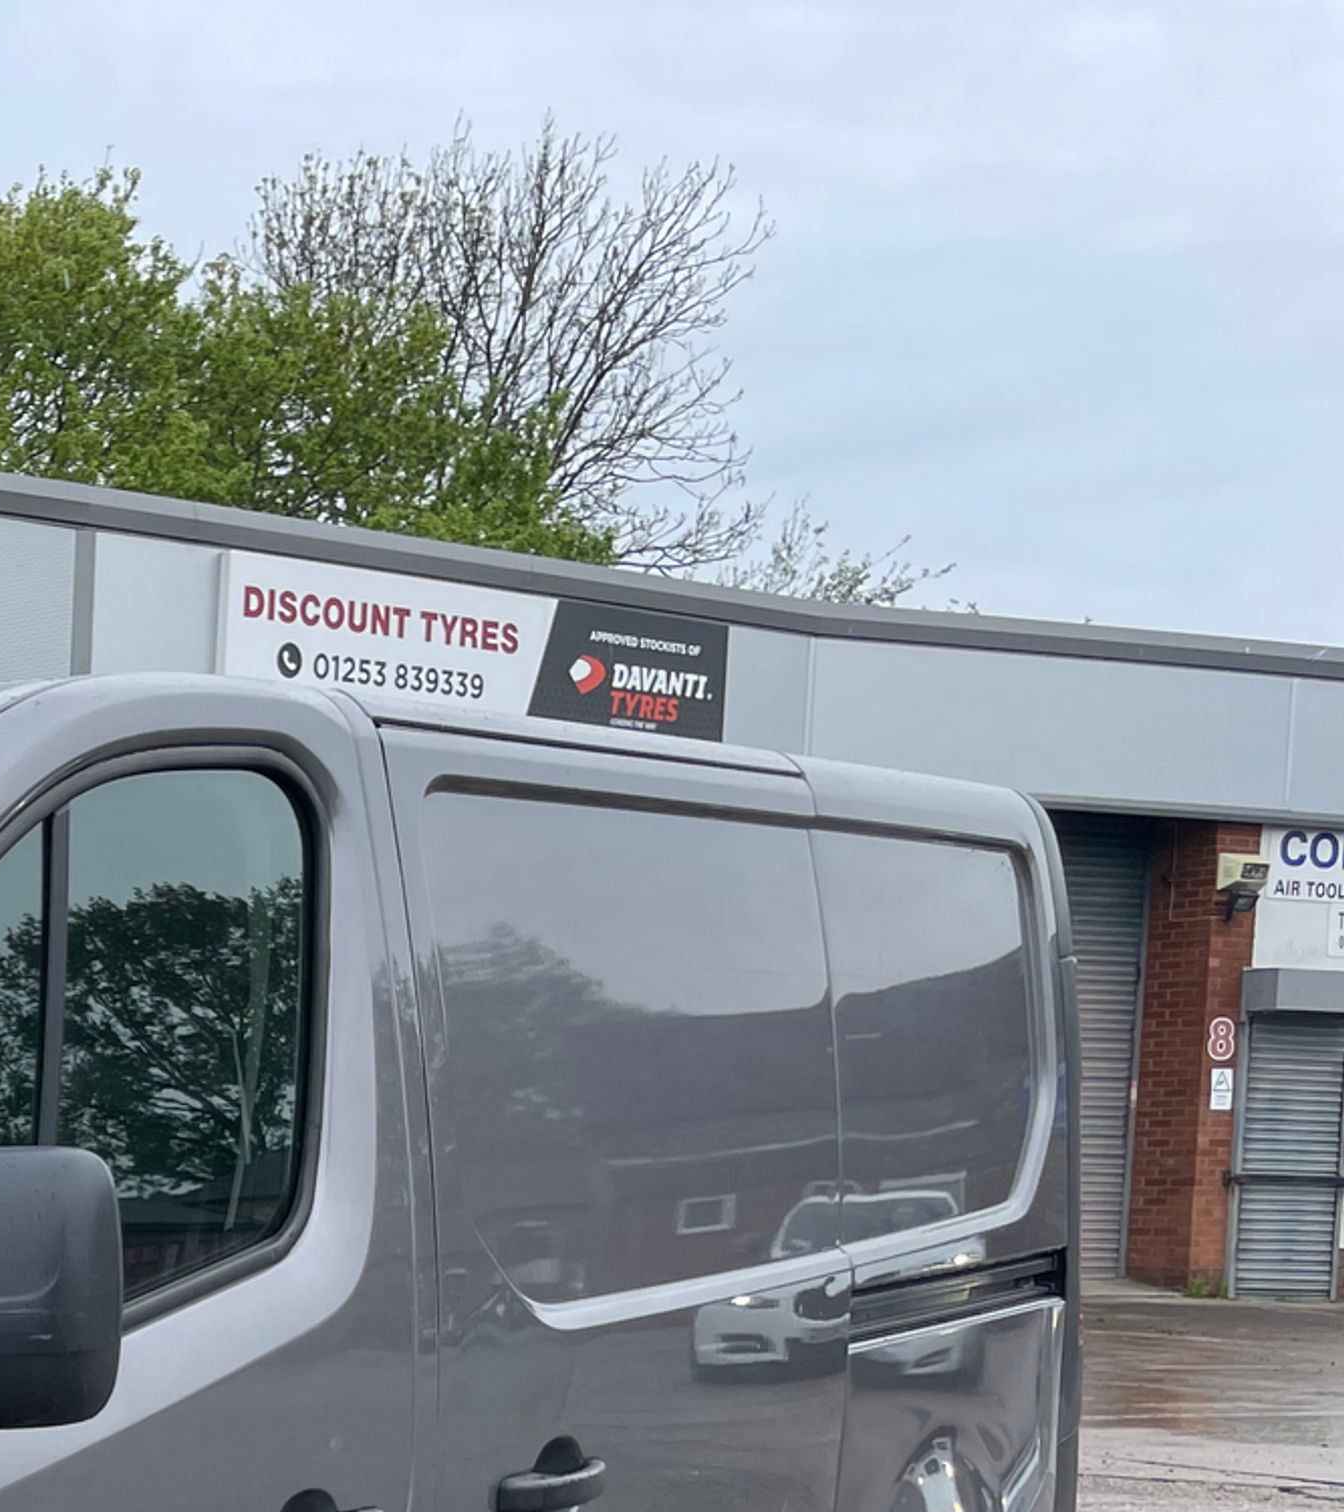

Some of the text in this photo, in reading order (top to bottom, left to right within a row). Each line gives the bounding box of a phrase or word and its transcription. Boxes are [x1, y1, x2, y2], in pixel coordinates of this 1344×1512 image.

[242, 585, 519, 654] DISCOUNT TYRES
[590, 630, 701, 656] APPROVED STOCKISTS OF
[313, 653, 484, 699] 01253 839339
[610, 690, 679, 722] TYRES
[1280, 830, 1344, 869] CO
[1274, 879, 1300, 896] AIR
[1207, 1017, 1235, 1061] 8
